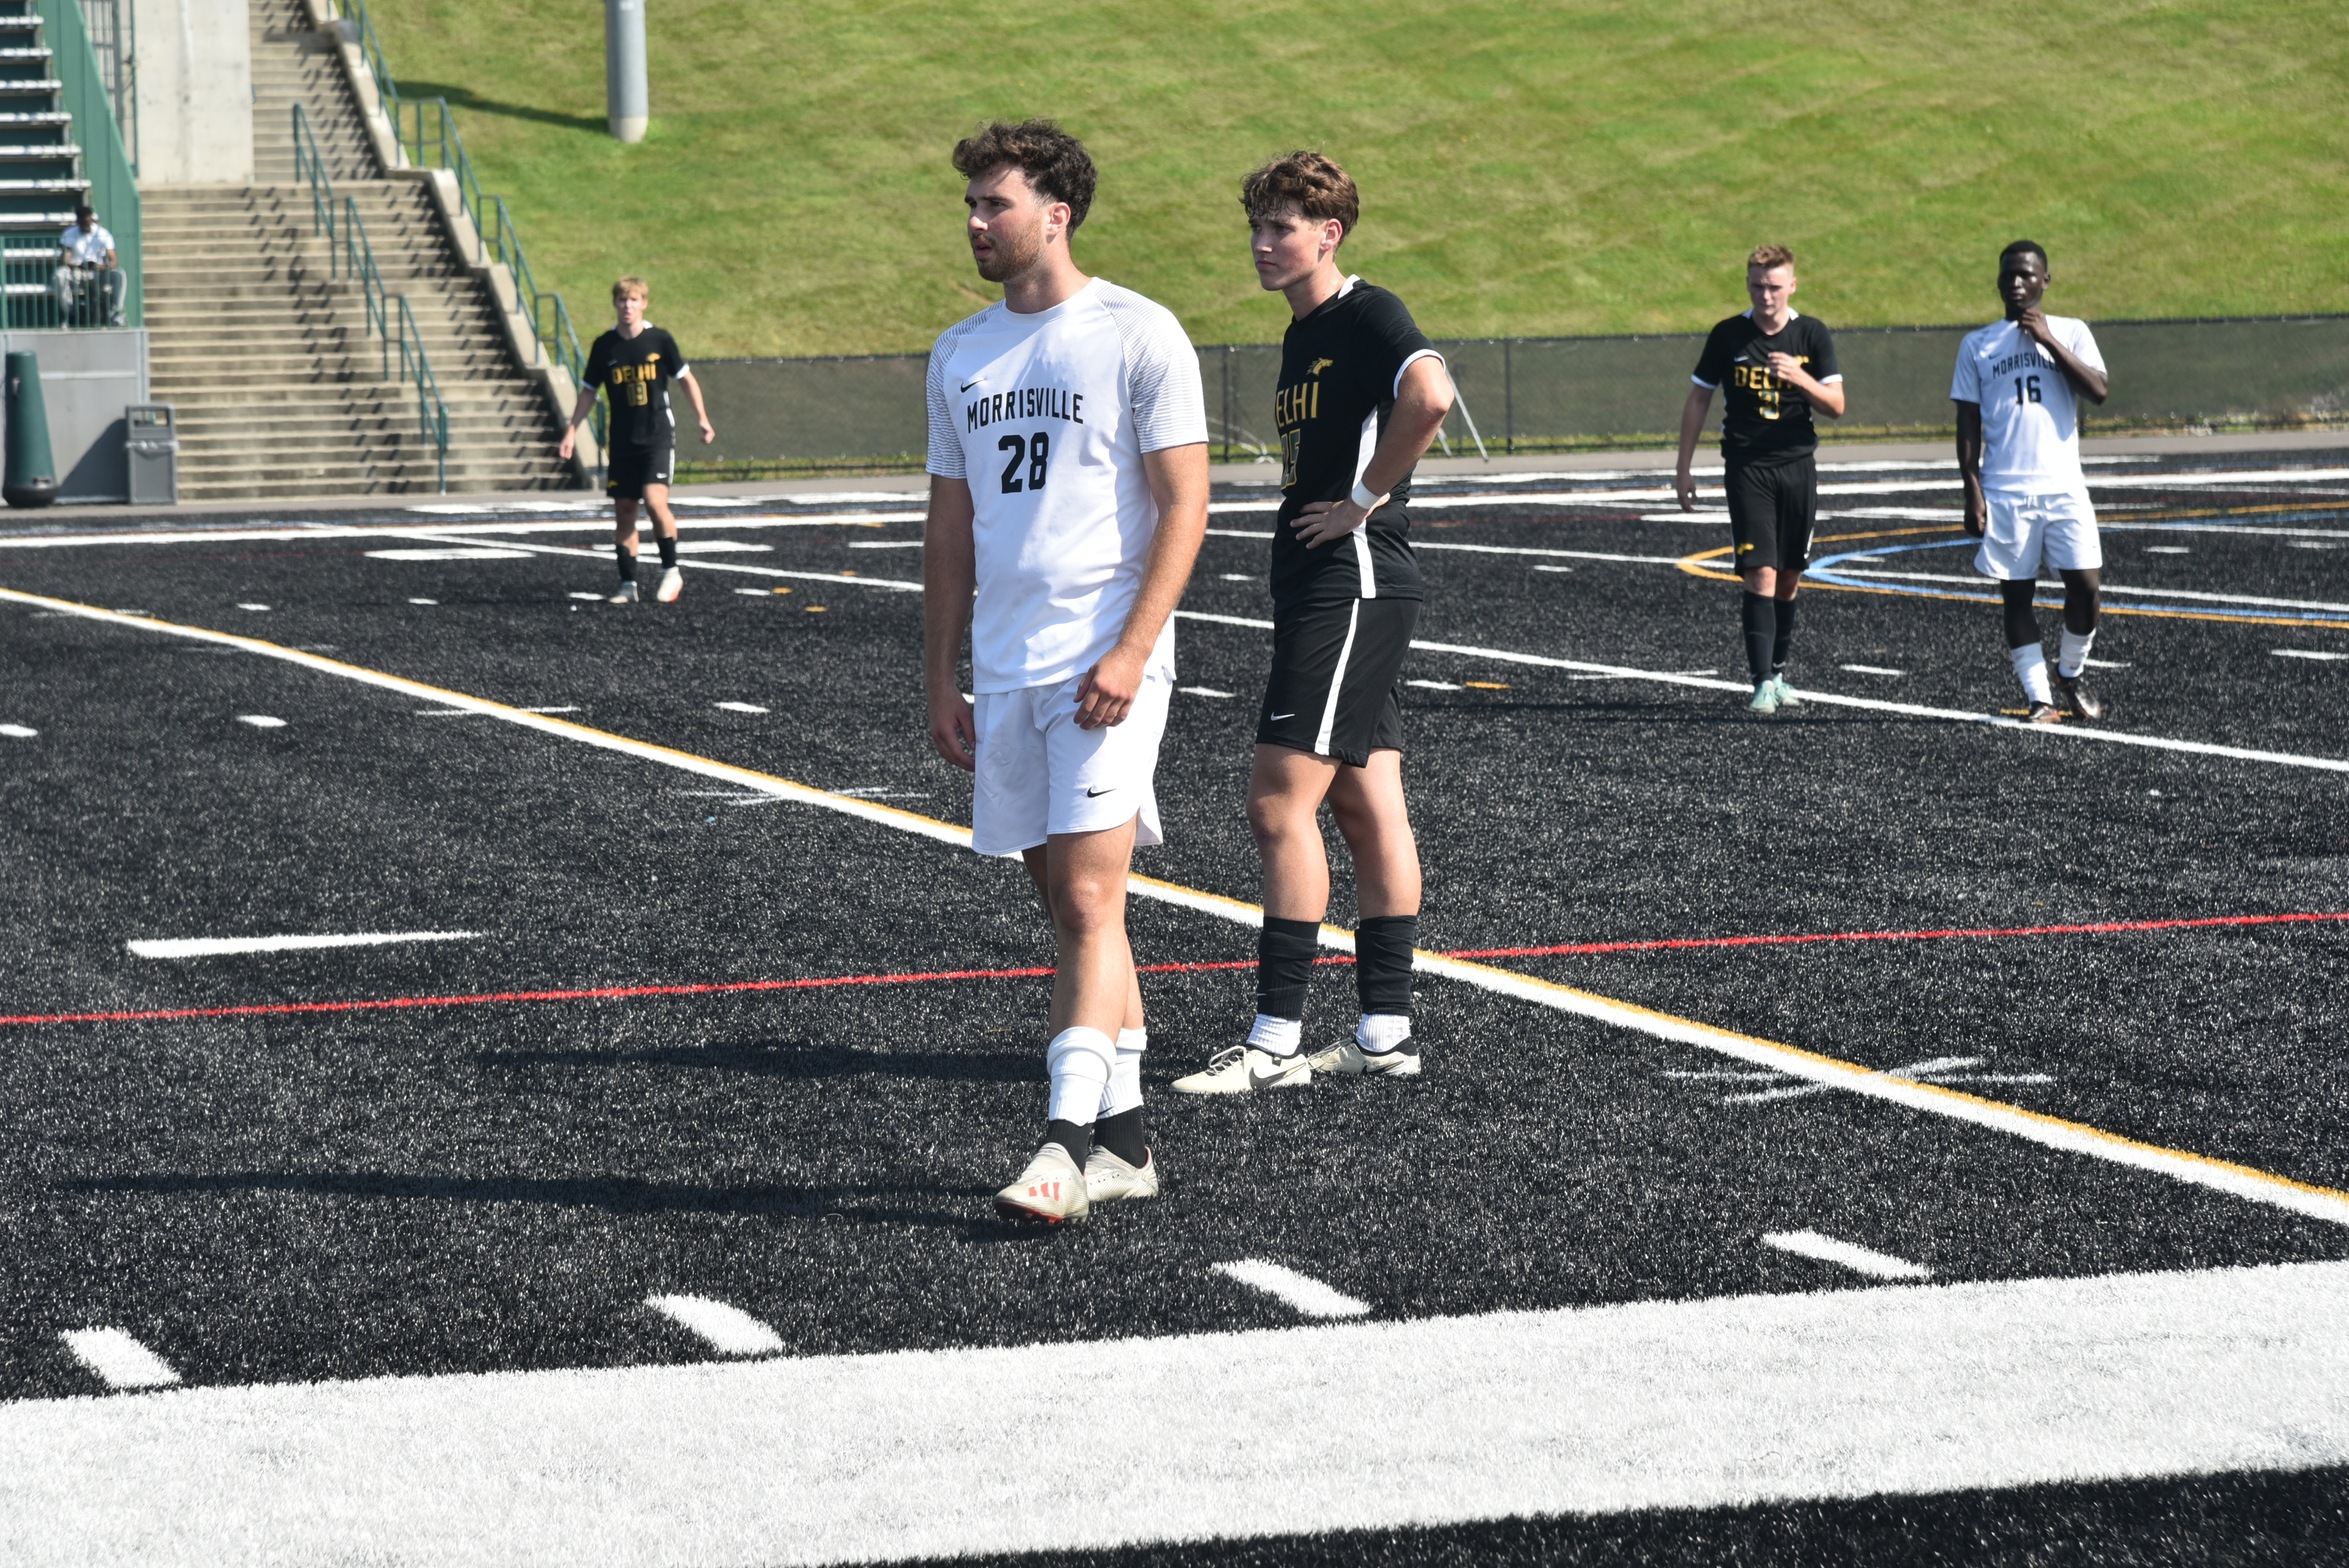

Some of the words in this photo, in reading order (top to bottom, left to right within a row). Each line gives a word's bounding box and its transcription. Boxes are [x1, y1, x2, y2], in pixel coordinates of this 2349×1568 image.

[1758, 390, 1780, 420] 3
[2014, 375, 2042, 405] 16
[967, 387, 1084, 434] MORRISVILLE
[998, 431, 1050, 494] 28
